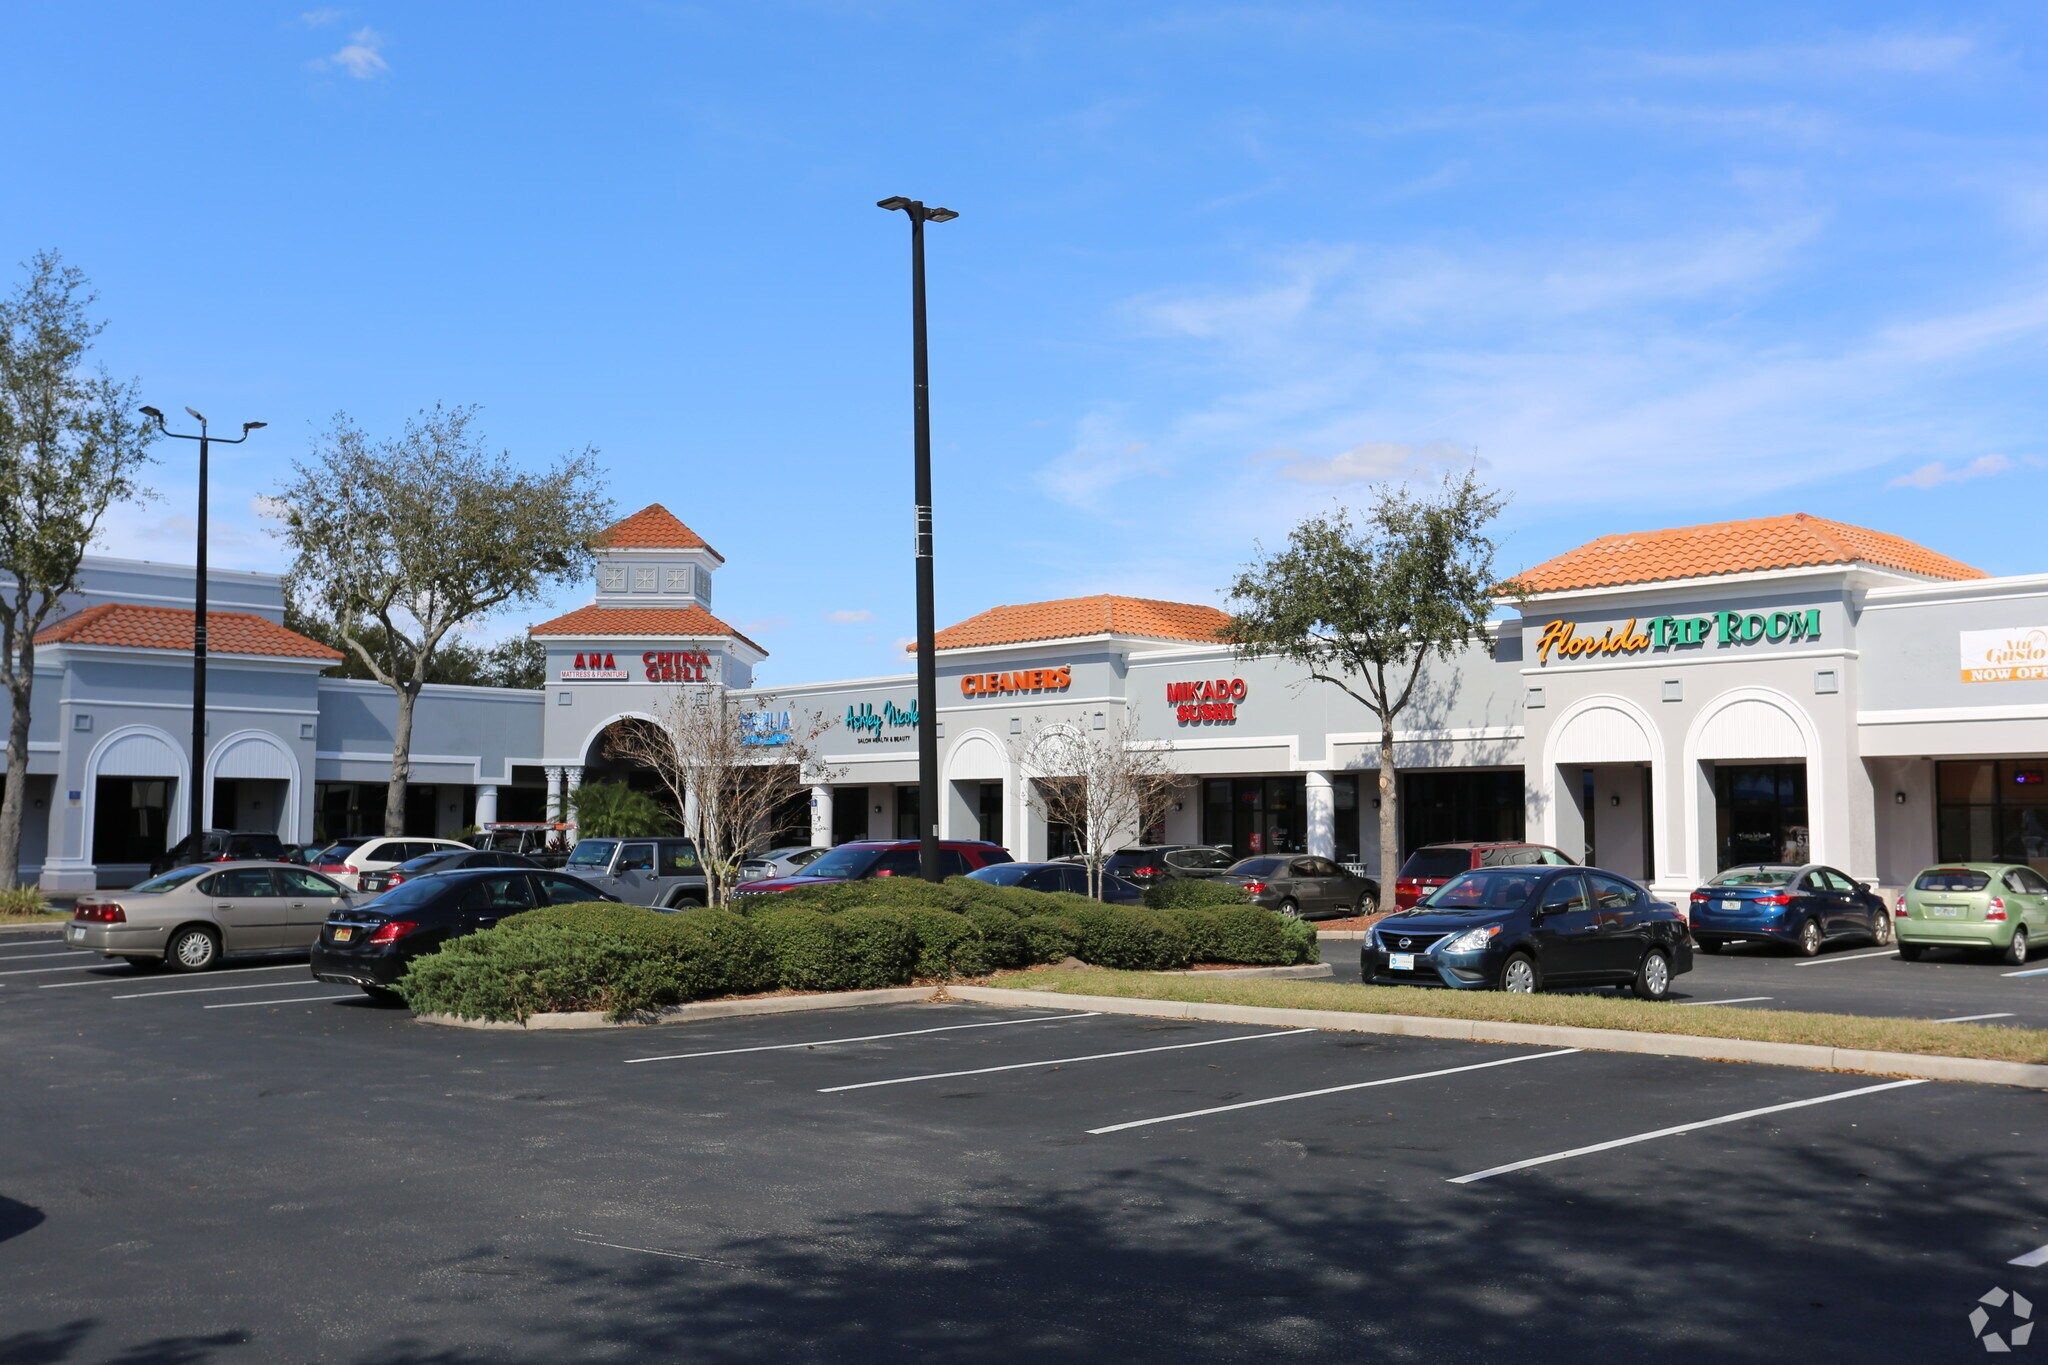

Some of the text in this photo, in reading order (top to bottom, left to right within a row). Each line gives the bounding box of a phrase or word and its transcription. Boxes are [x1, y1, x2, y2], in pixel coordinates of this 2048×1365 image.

[1536, 608, 1821, 663] Florida TAP ROOM
[573, 652, 616, 669] ANA
[642, 650, 711, 668] CHINA
[561, 670, 590, 678] MATTRESS
[597, 670, 627, 678] FURNITURE
[645, 666, 706, 682] GRILL
[960, 667, 1072, 696] CLEANERS
[1970, 668, 2012, 681] NOW
[1167, 678, 1247, 703] MIKADO
[844, 698, 919, 737] Ashley Nicole
[1176, 702, 1237, 723] SUSHI
